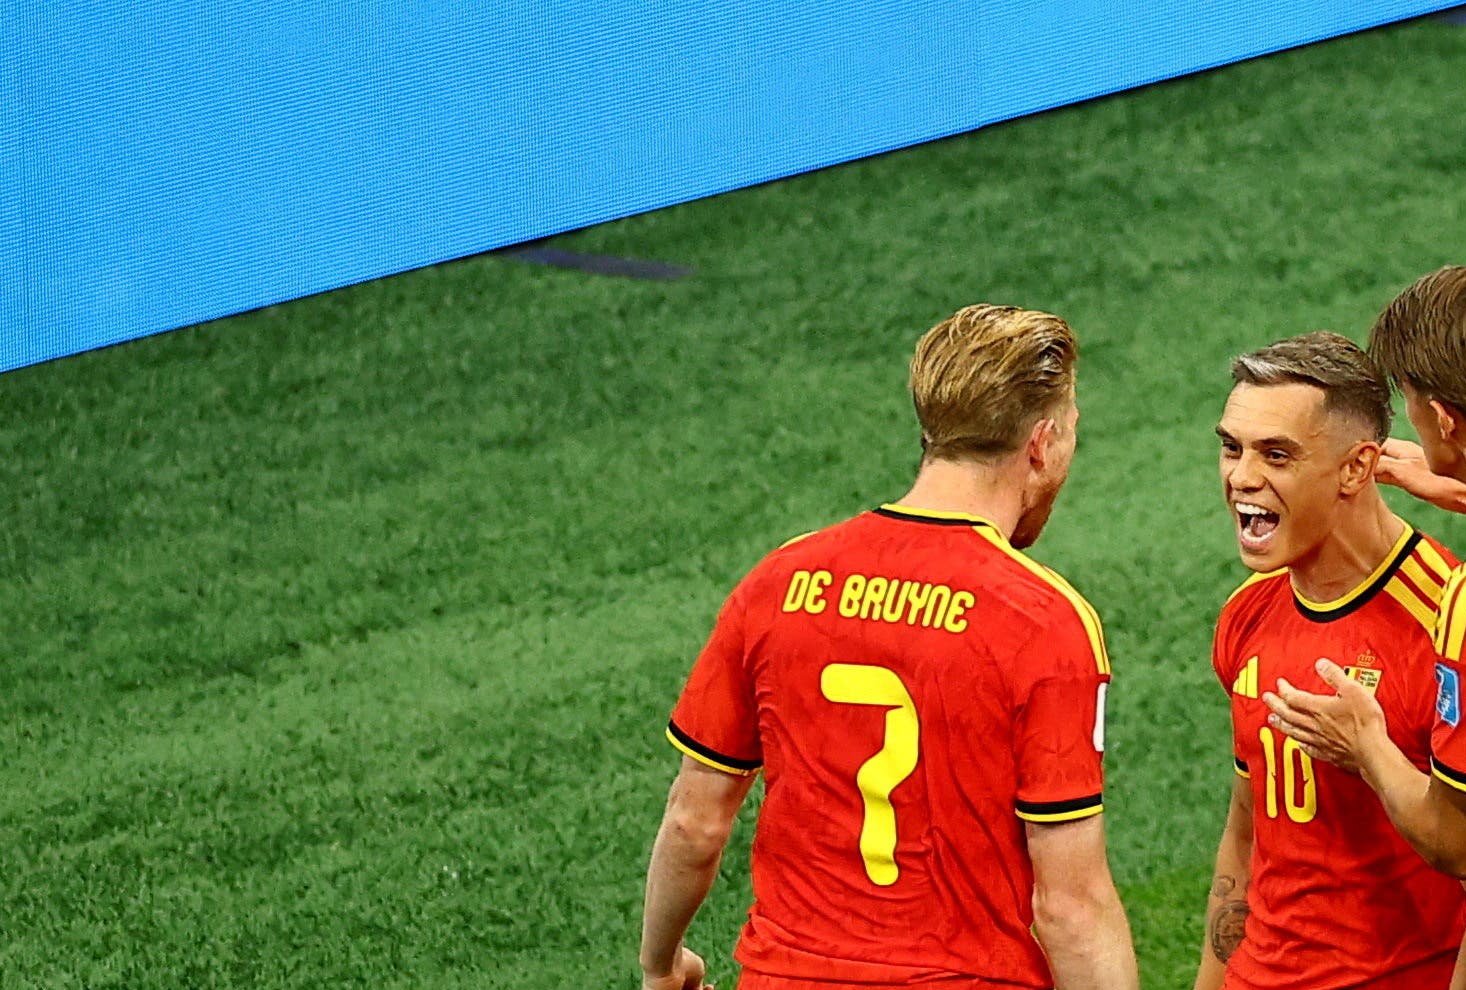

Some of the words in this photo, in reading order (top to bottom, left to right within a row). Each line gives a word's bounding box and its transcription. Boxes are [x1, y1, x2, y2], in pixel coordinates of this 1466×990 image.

[782, 570, 832, 614] DE
[838, 574, 975, 633] BRUYNE
[820, 663, 920, 886] 7
[1259, 726, 1317, 823] 10
